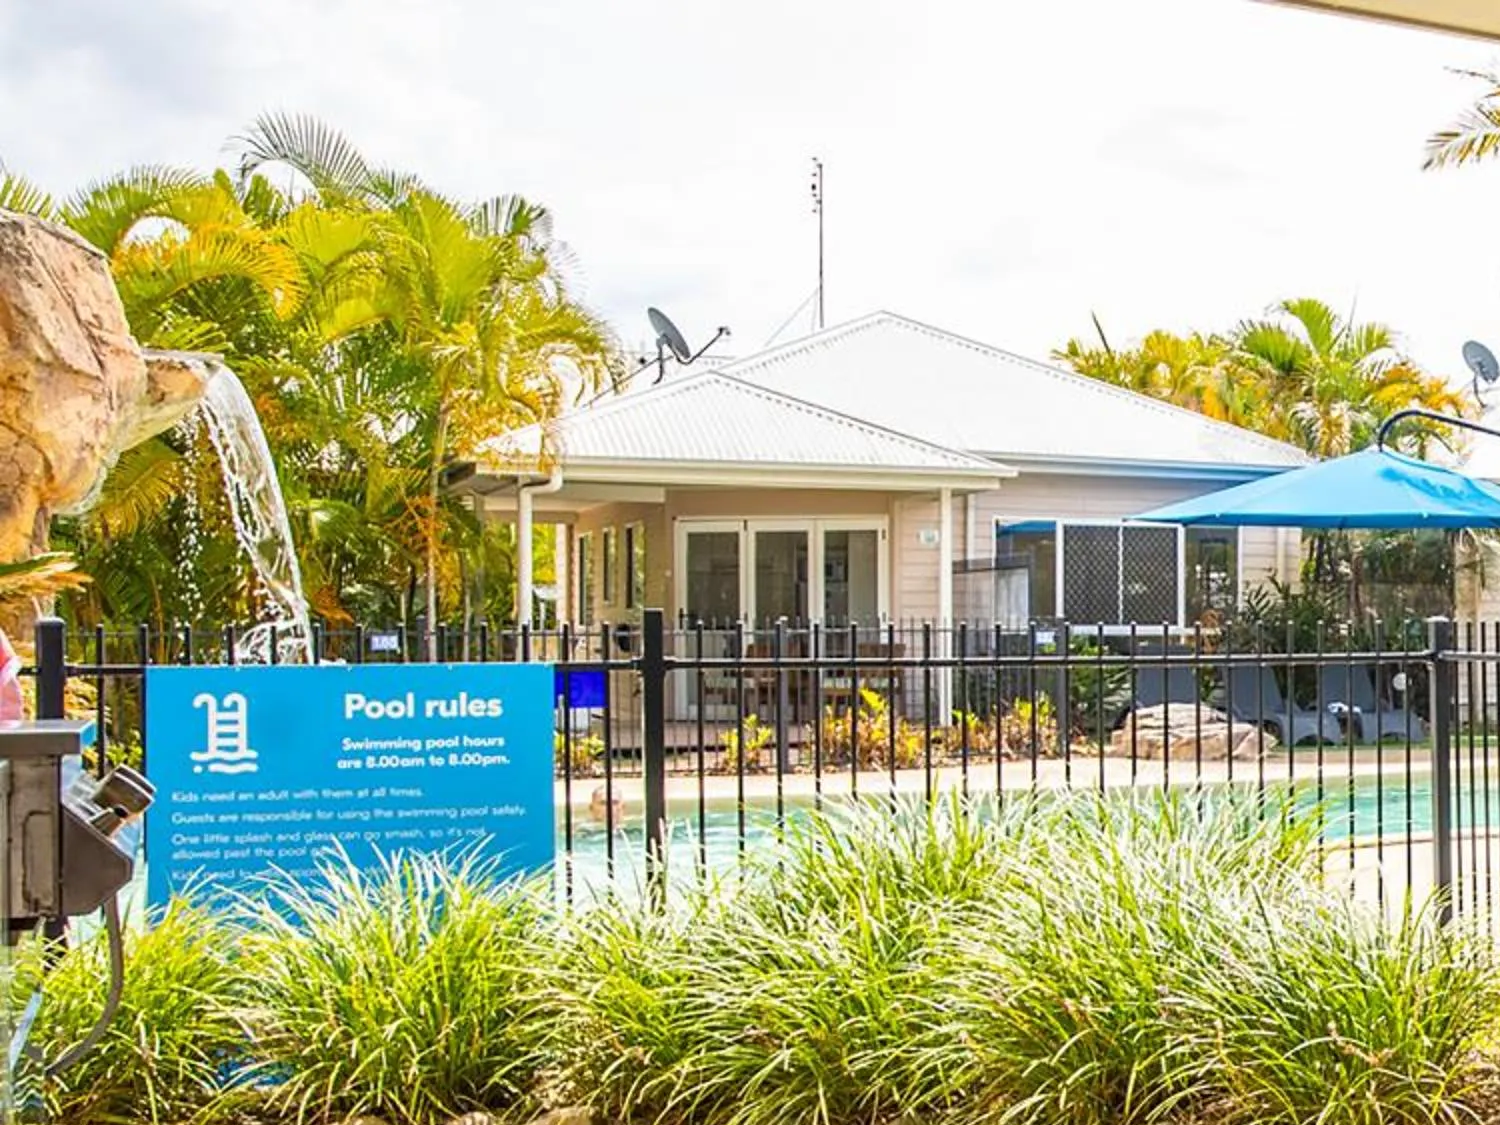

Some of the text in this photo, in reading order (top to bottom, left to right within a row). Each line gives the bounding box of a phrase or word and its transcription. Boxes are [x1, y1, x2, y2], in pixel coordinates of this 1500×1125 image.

[345, 692, 504, 719] Pool rules
[342, 735, 505, 751] Swimming pool hours
[337, 757, 362, 769] are
[366, 756, 425, 768] 8.00am
[429, 755, 445, 767] to
[172, 790, 198, 803] Kids
[203, 789, 235, 801] need
[238, 791, 255, 801] an
[258, 789, 289, 800] adult
[292, 789, 318, 800] with
[321, 788, 352, 798] them
[357, 787, 369, 798] at
[172, 812, 215, 824] Guests
[218, 814, 239, 823] are
[242, 810, 313, 822] responsible
[316, 809, 334, 819] for
[337, 809, 370, 820] using
[373, 808, 394, 817] the
[397, 807, 458, 819] swimming
[461, 805, 488, 817] pool
[172, 833, 200, 845] One
[204, 832, 230, 843] little
[234, 832, 272, 845] splash
[276, 832, 300, 842] and
[338, 831, 360, 840] can
[363, 830, 380, 841] go
[429, 829, 443, 838] so
[172, 848, 221, 860] allowed
[224, 847, 251, 859] past
[254, 845, 275, 857] the
[278, 845, 307, 858] pool
